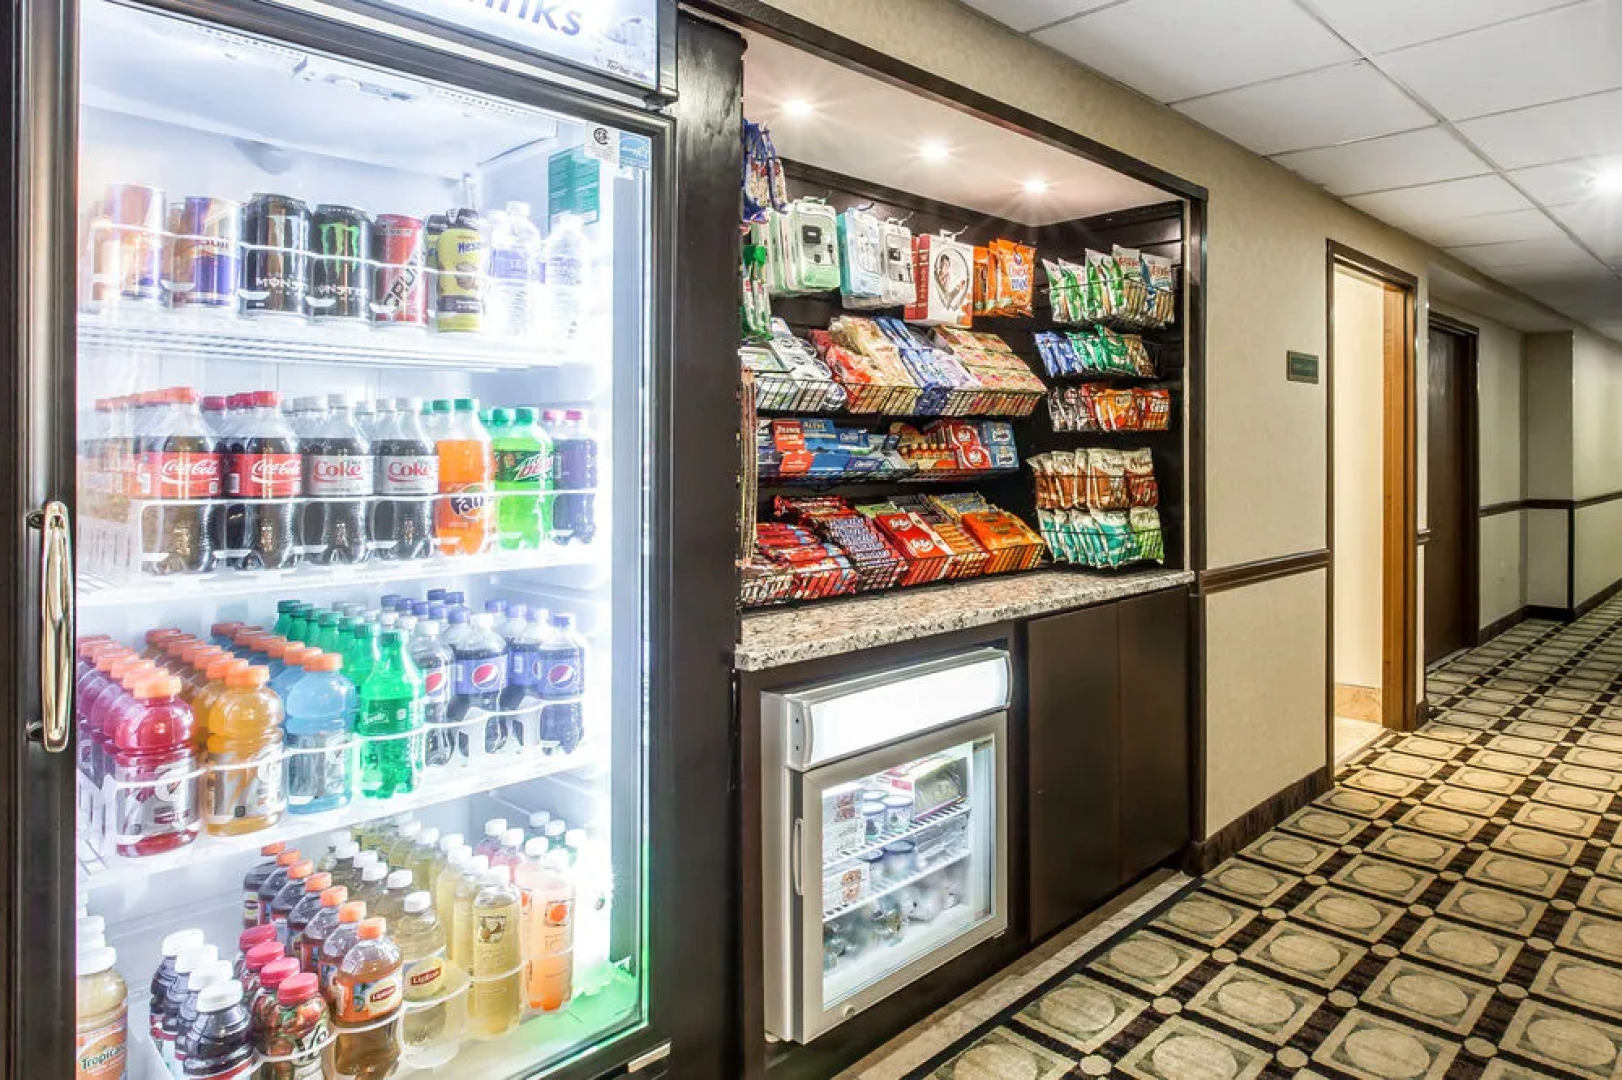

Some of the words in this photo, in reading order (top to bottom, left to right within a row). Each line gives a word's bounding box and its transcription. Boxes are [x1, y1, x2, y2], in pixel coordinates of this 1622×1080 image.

[162, 458, 220, 478] Coca-Cola
[251, 458, 301, 478] Coca-Cola
[313, 459, 362, 481] Coke
[387, 460, 432, 481] Coke
[413, 967, 441, 985] Lipton
[371, 986, 396, 1002] Lipton
